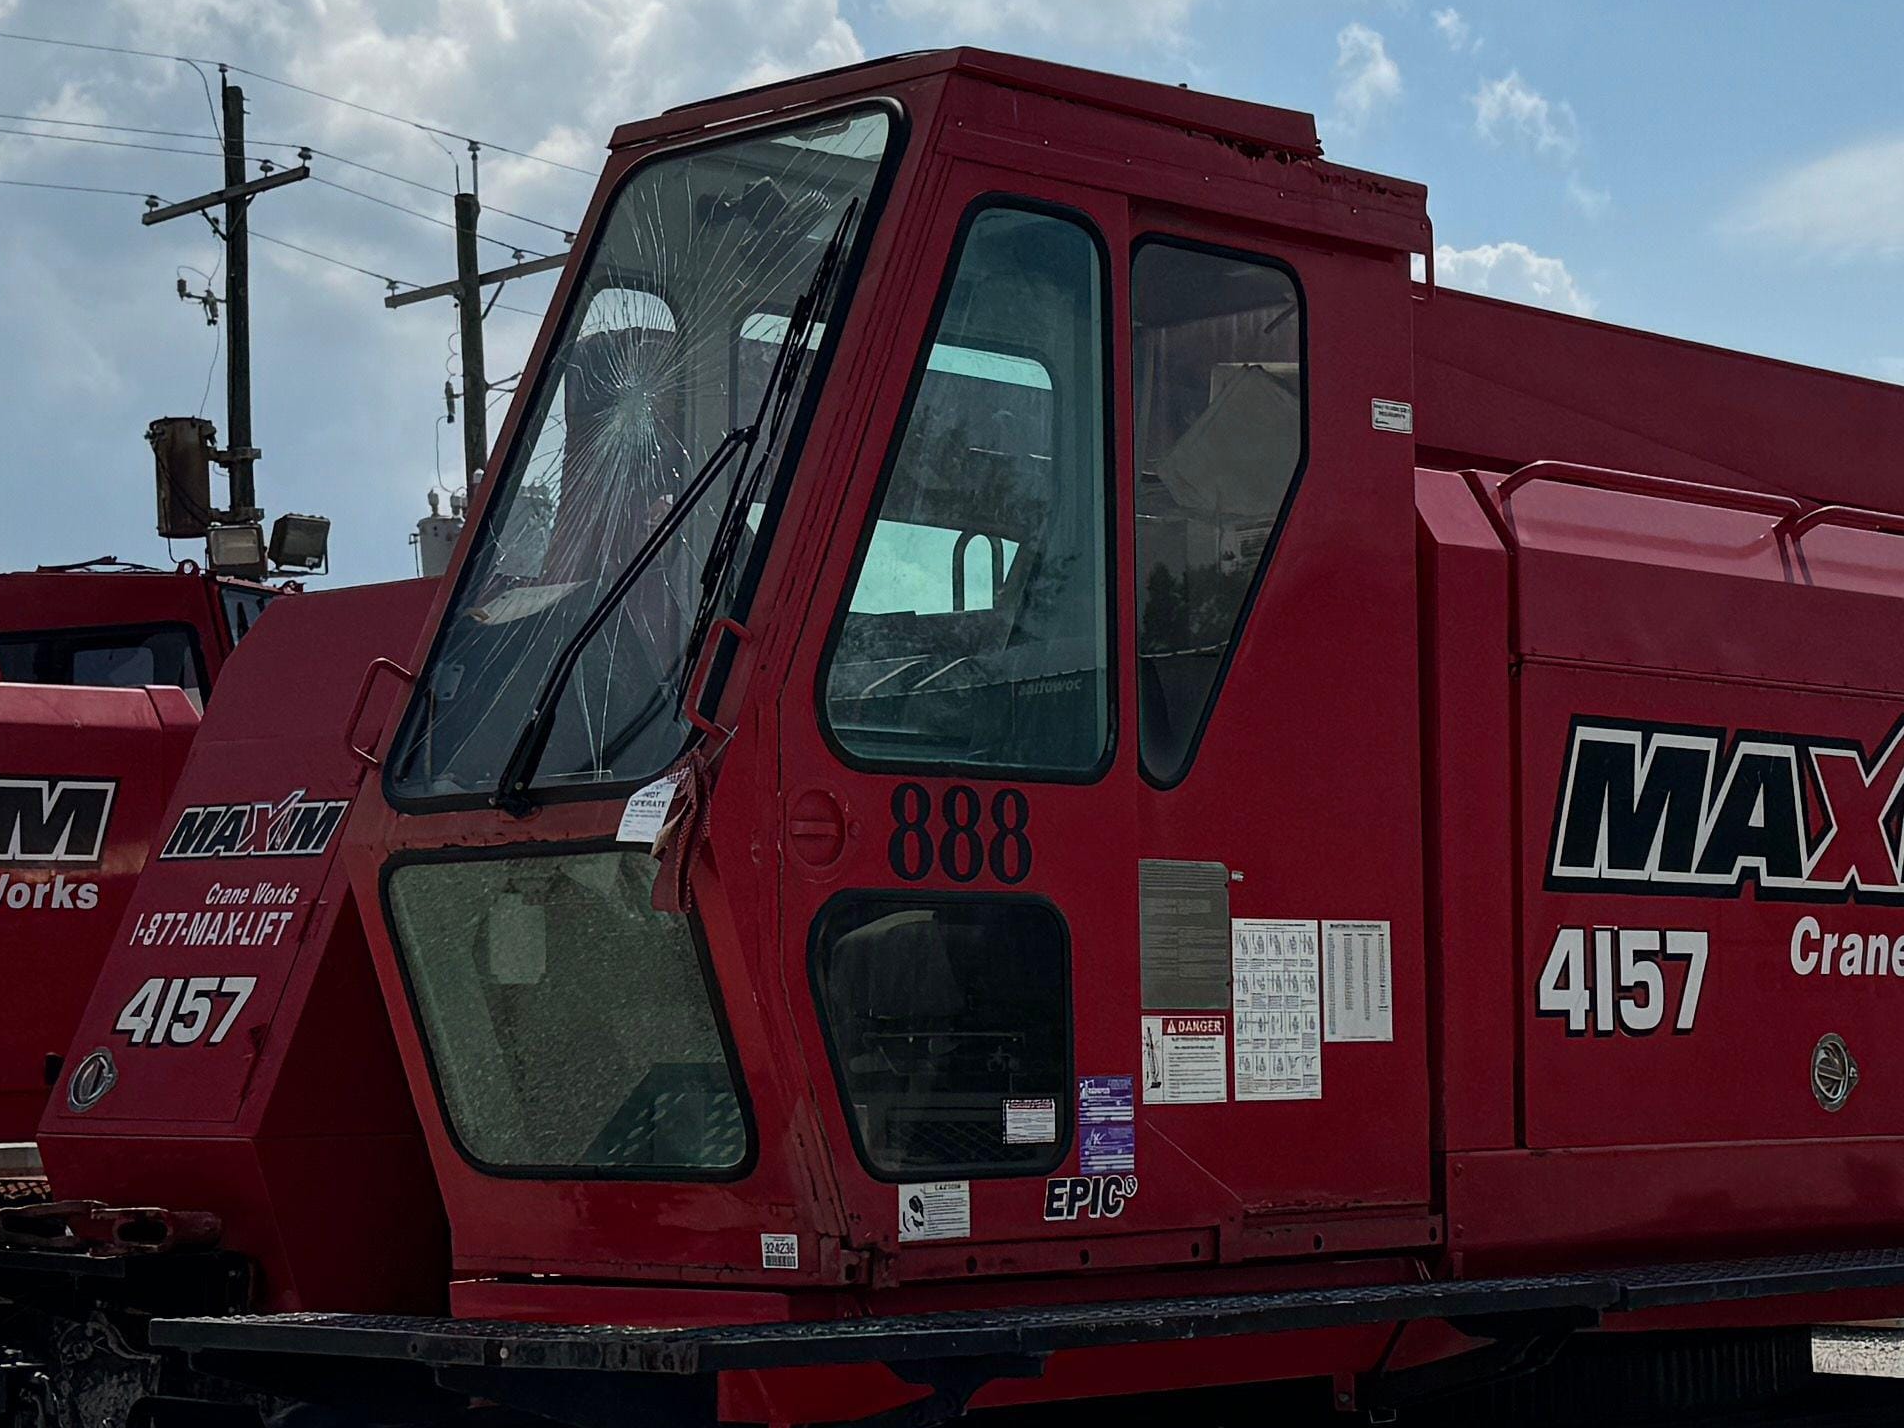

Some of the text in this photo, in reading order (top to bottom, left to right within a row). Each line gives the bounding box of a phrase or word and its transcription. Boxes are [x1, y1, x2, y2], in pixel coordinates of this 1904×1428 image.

[159, 788, 350, 860] MAXIM
[888, 782, 1033, 885] 888
[205, 882, 300, 905] Crane Works
[129, 912, 294, 946] 1-877-MAX-LIFT
[115, 976, 257, 1045] 4157
[1539, 928, 1709, 1032] 4157
[1178, 1020, 1222, 1032] DANGER
